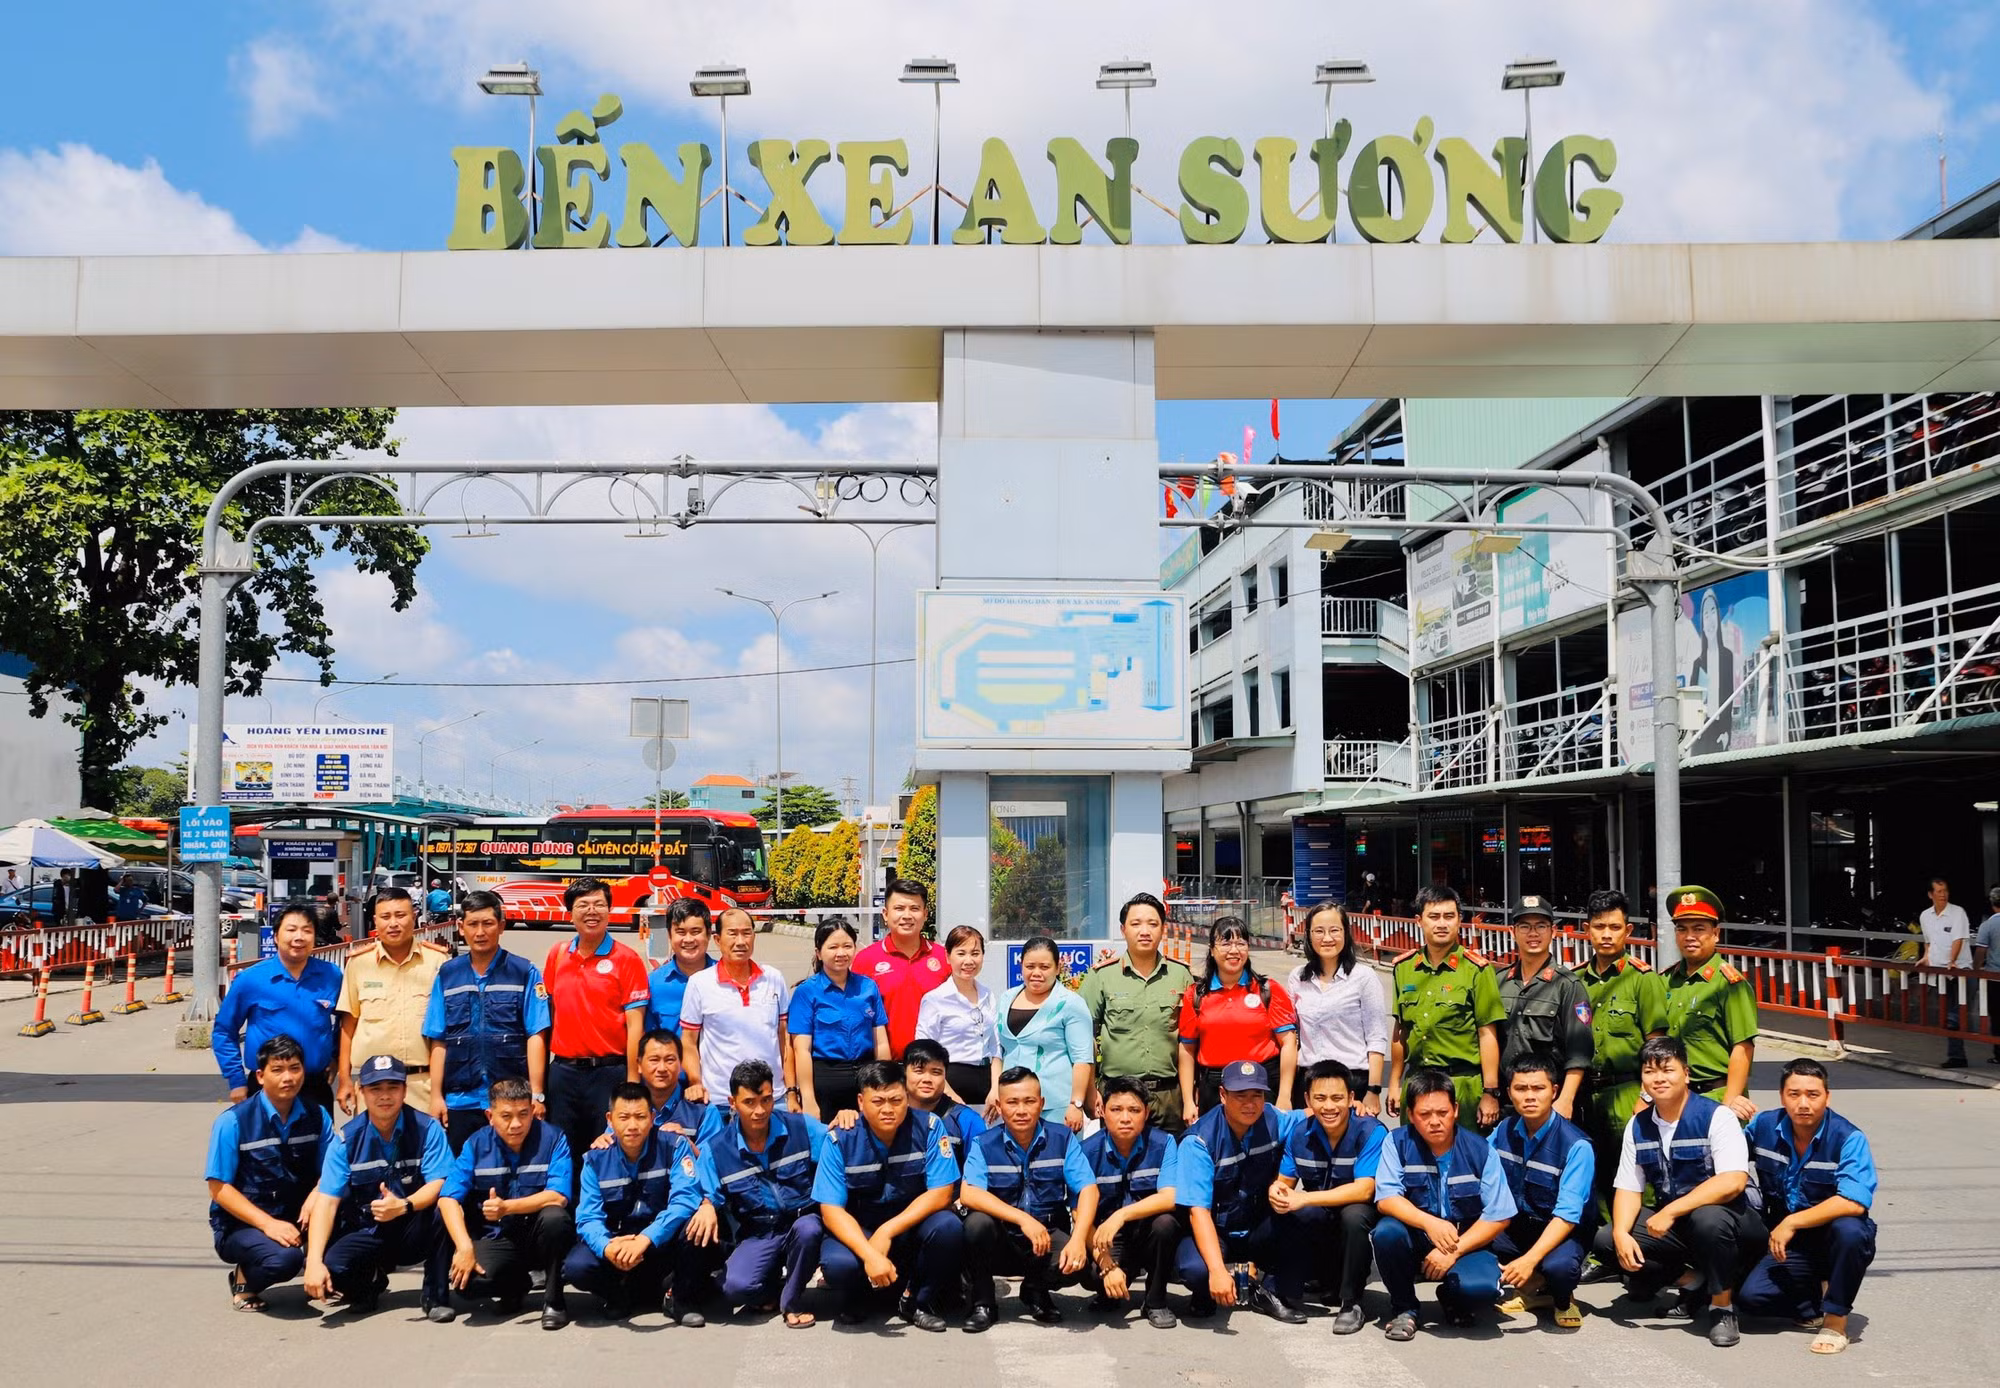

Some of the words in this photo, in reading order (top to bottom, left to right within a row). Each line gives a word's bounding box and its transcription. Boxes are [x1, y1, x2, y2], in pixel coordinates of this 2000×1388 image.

[447, 93, 711, 250] BẾN
[743, 138, 914, 246] XE
[952, 136, 1139, 245] AN
[1178, 115, 1624, 244] SƯƠNG
[247, 725, 292, 735] HOÀNG
[296, 724, 321, 735] YẾN
[325, 727, 388, 735] LIMOSINE
[186, 818, 200, 827] LỐI
[202, 818, 223, 826] VÀO
[202, 829, 228, 837] BÁNH
[480, 842, 529, 855] QUANG
[532, 840, 574, 855] DŨNG
[622, 843, 639, 855] CƠ
[664, 842, 688, 855] ĐẤT
